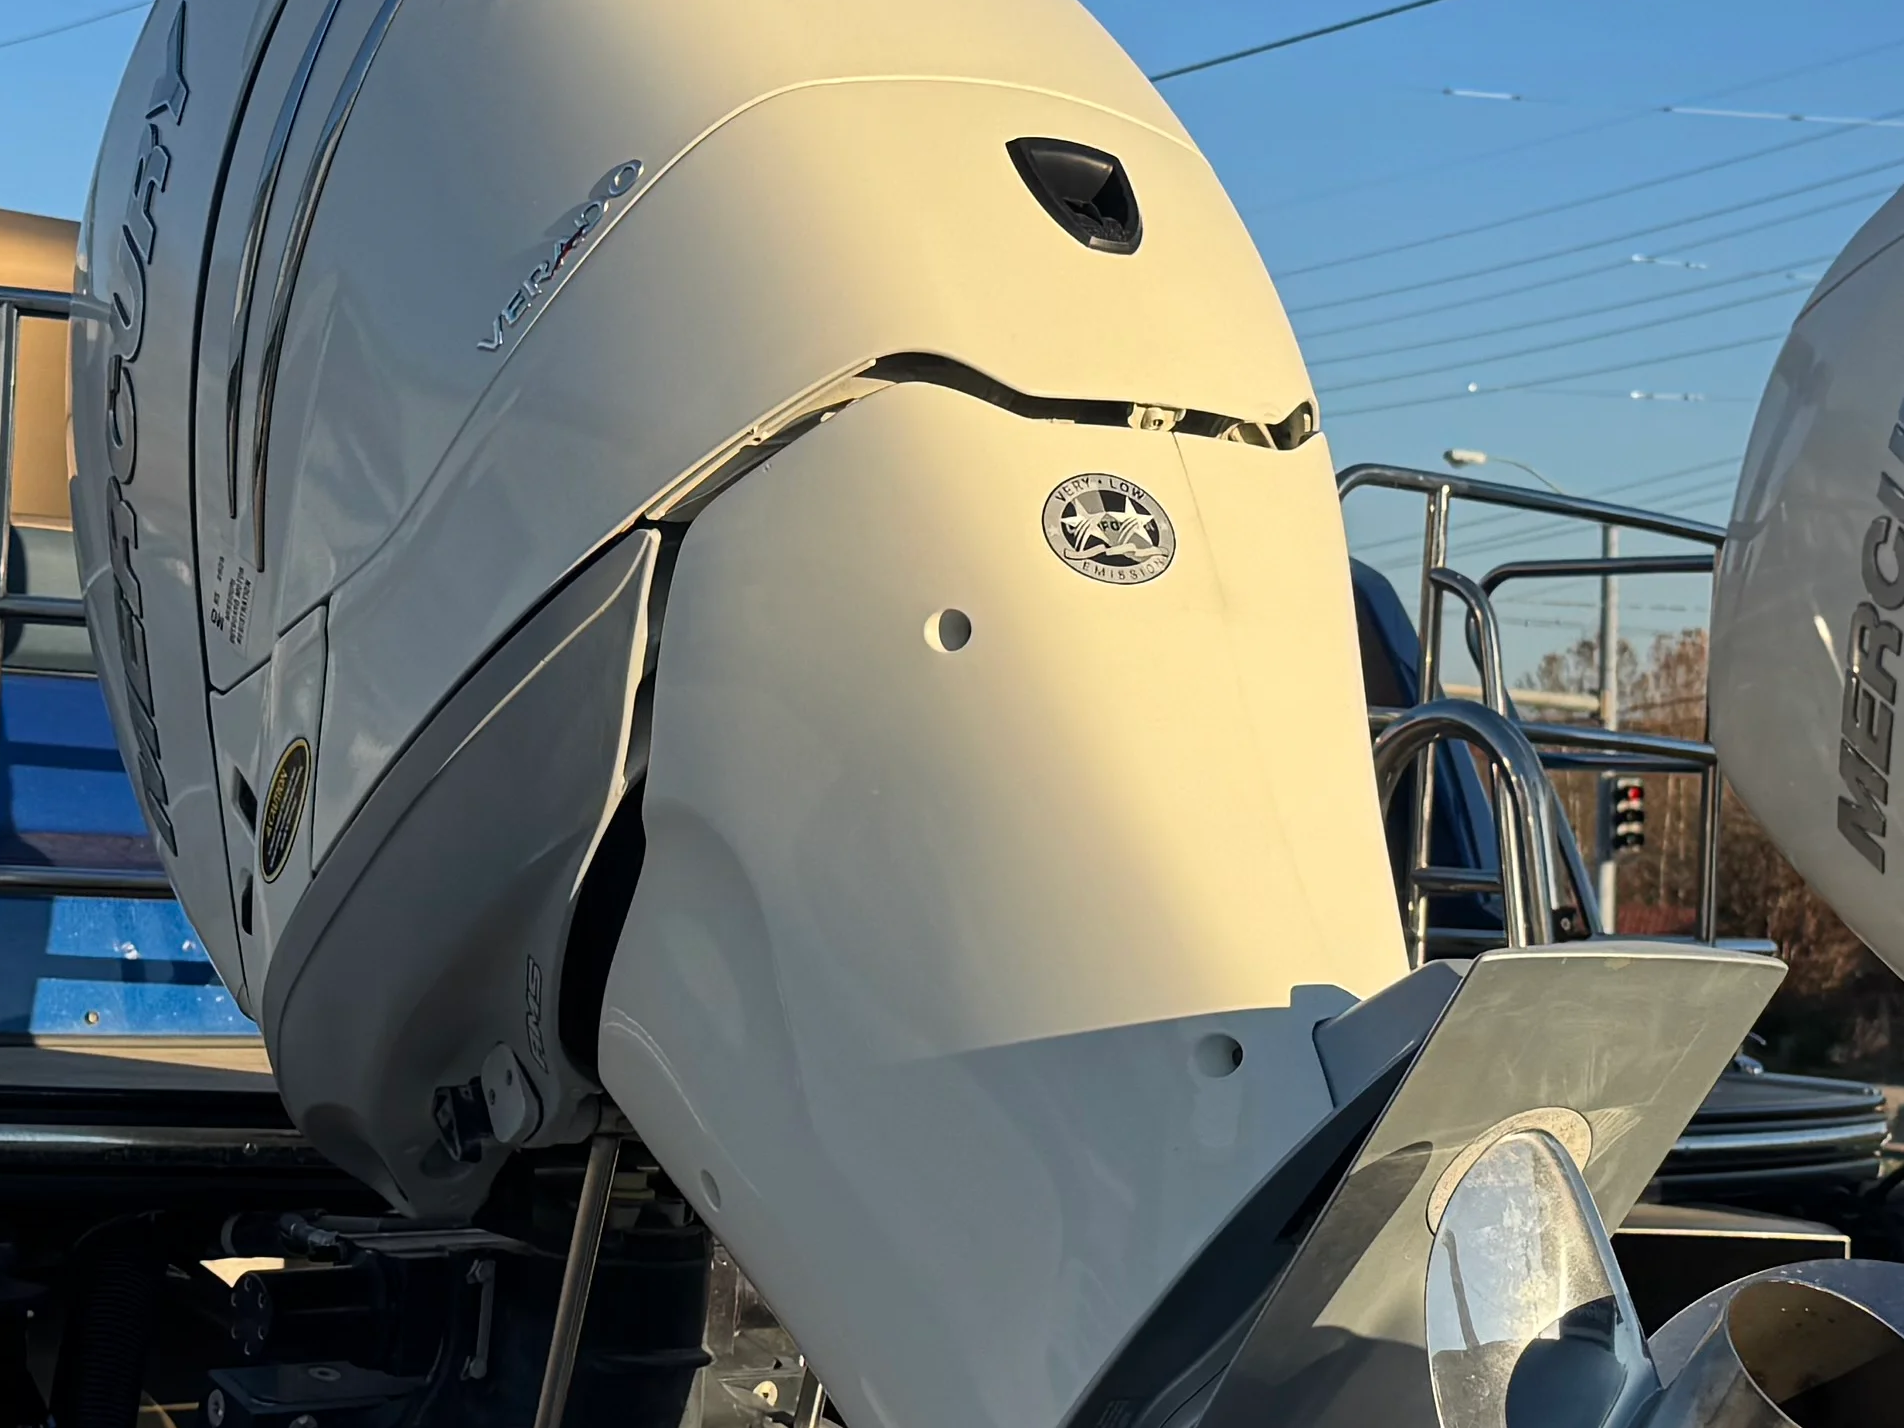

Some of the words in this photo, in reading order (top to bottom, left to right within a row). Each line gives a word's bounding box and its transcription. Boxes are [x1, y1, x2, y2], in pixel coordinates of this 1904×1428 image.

[476, 158, 645, 349] VERADO
[1054, 476, 1091, 503] VERY
[1109, 478, 1145, 501] LOW
[1082, 555, 1167, 581] EMISSION
[268, 768, 287, 826] CAUTION
[526, 954, 548, 1074] AMS
